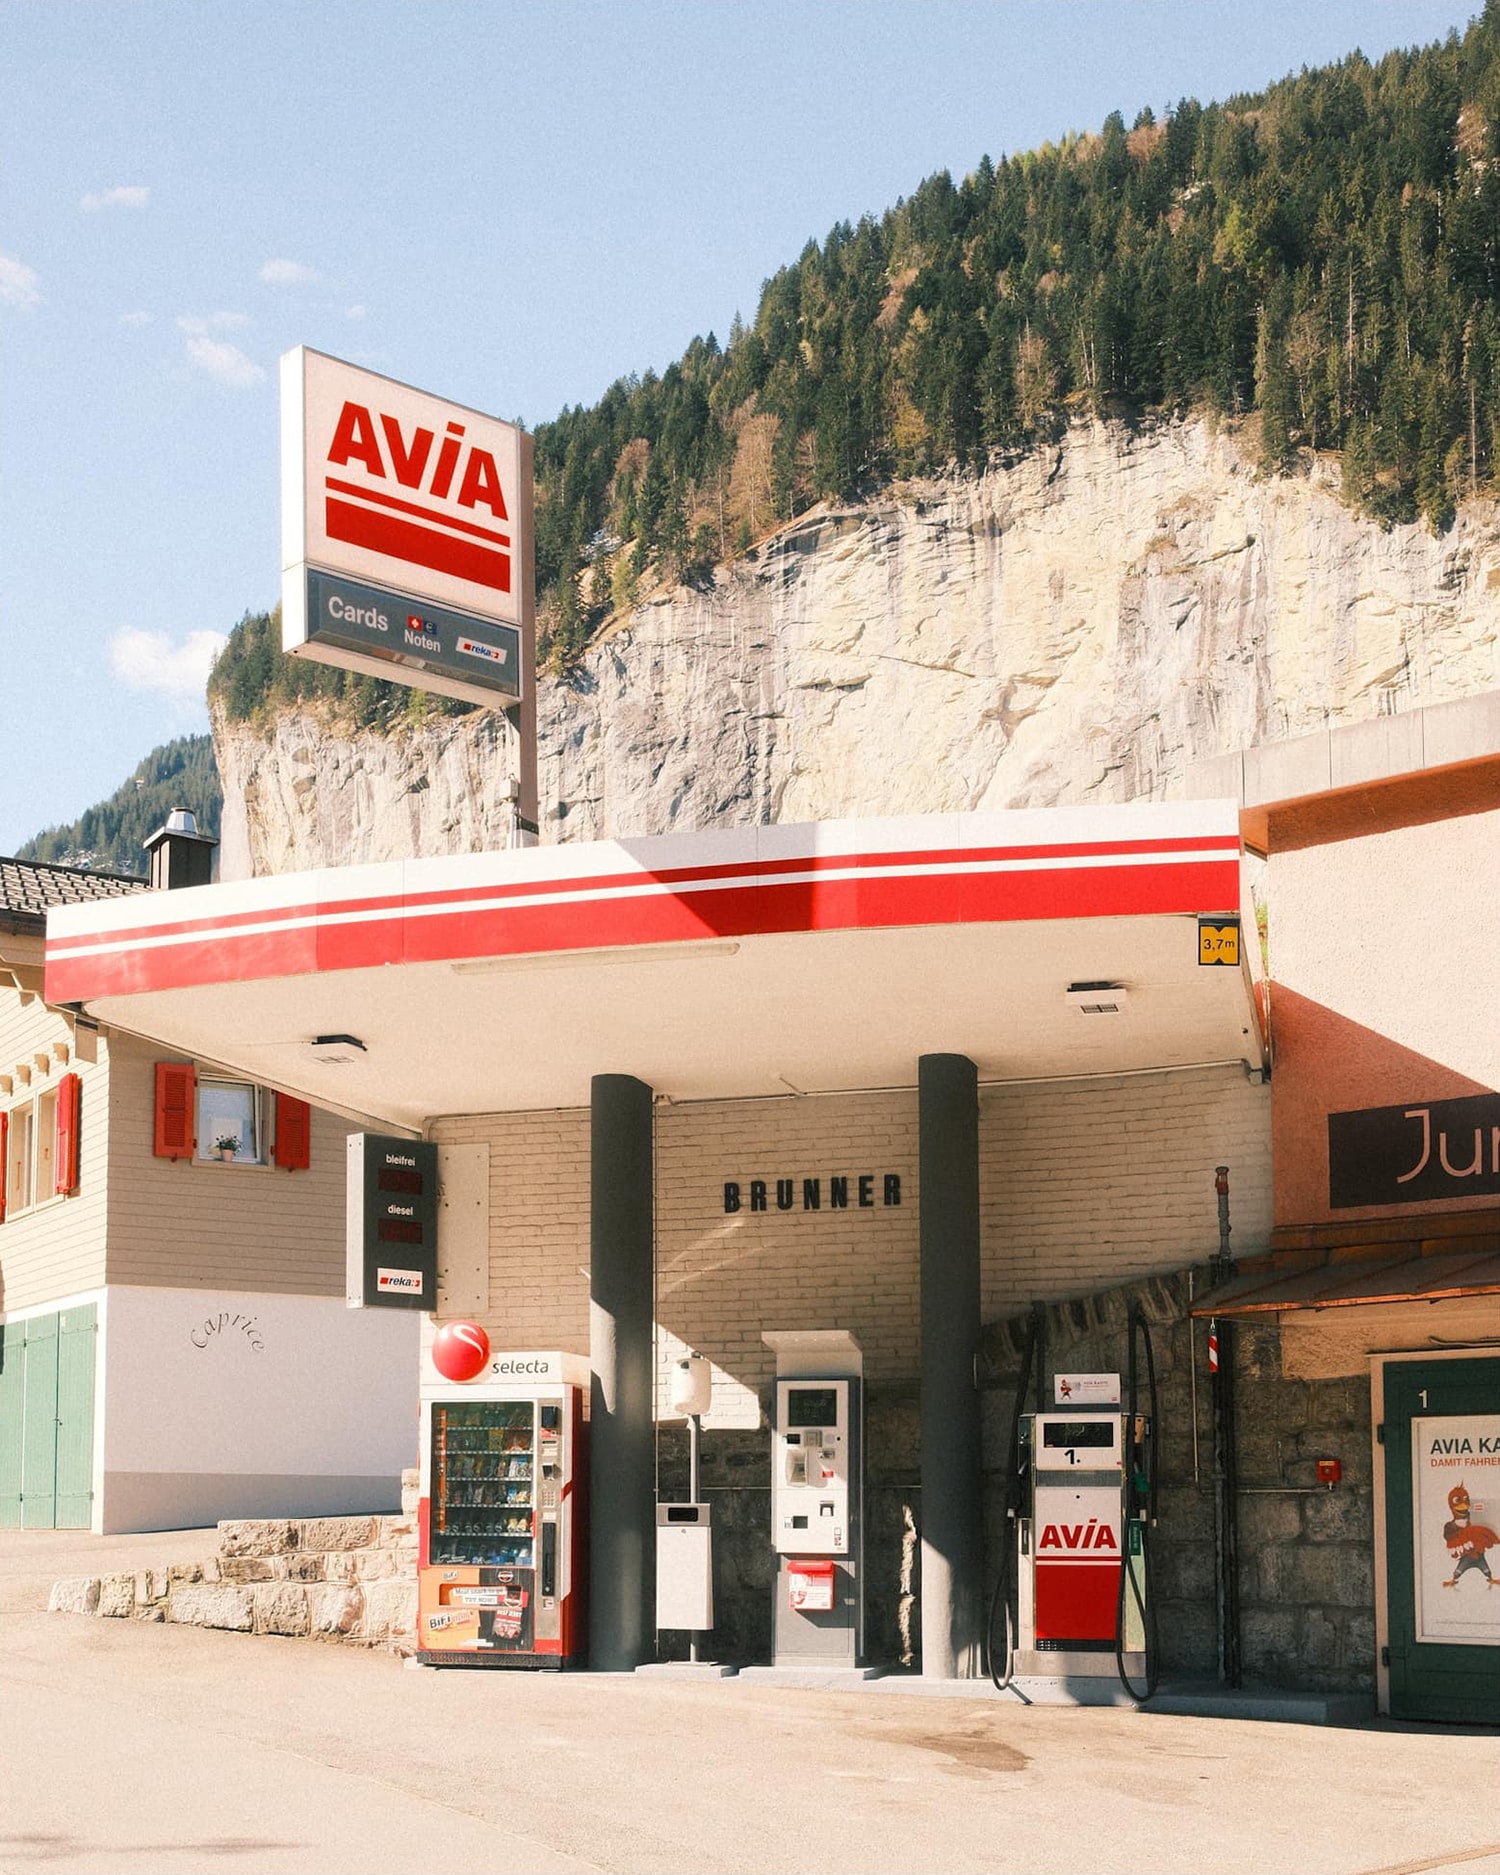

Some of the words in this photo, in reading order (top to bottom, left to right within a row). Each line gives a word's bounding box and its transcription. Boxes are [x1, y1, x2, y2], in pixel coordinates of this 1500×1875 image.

[328, 596, 389, 632] Cards
[404, 629, 441, 653] Noten
[1397, 1109, 1500, 1183] Ju
[385, 1154, 416, 1167] bleifrei
[724, 1174, 901, 1213] BRUNNER
[387, 1204, 414, 1216] diesel
[492, 1359, 549, 1375] selecta
[1418, 1389, 1428, 1409] 1
[1430, 1438, 1473, 1455] AVIA
[1431, 1458, 1462, 1467] DAMIT
